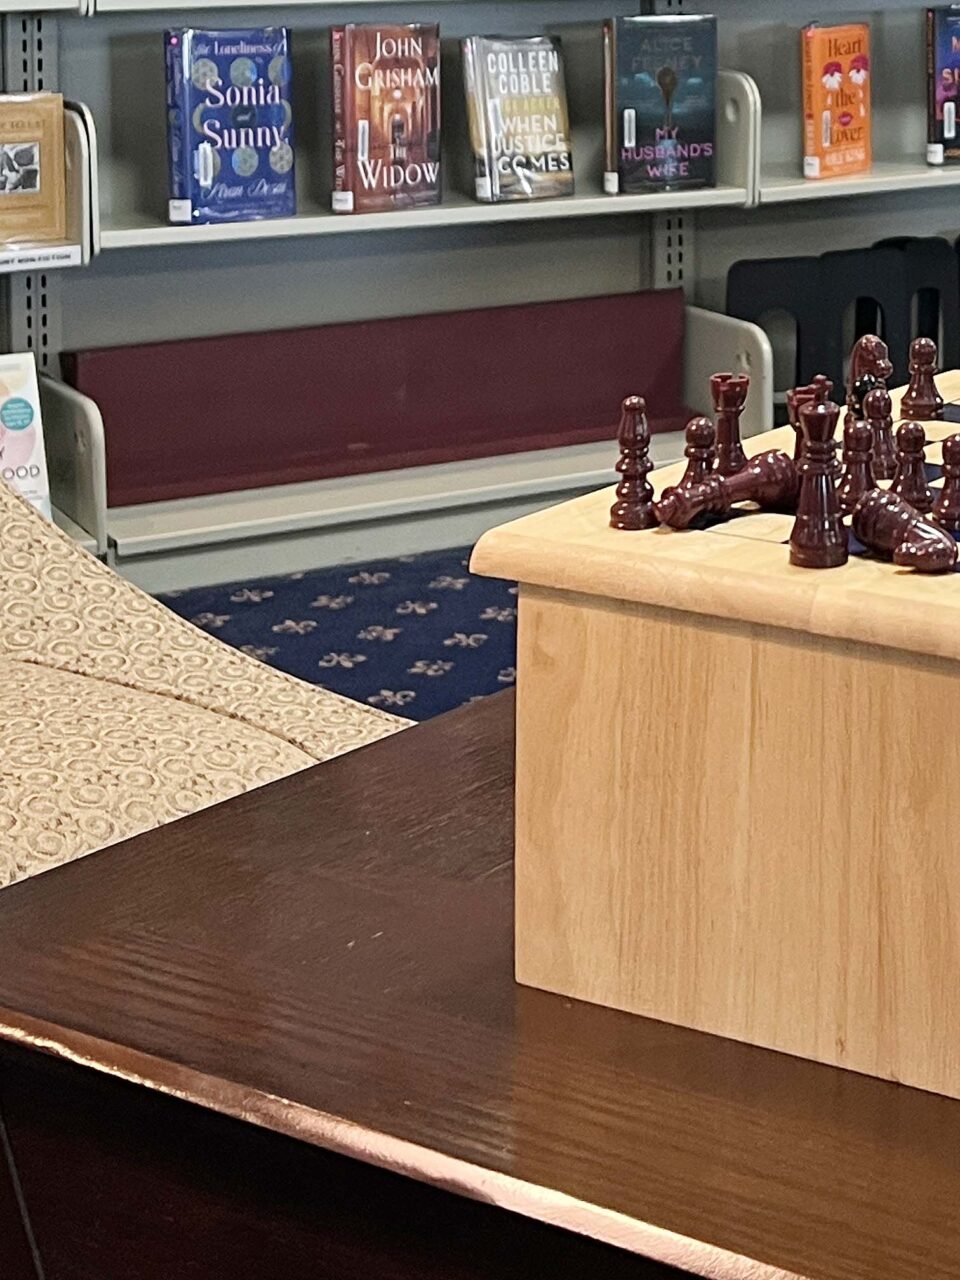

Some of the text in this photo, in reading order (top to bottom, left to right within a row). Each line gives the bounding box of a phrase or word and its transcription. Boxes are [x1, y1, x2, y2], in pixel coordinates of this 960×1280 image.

[375, 31, 423, 59] JOHN
[641, 35, 694, 53] ALICE
[828, 37, 863, 58] Heart
[487, 50, 559, 73] COLLEEN
[355, 61, 440, 91] GRISHAM
[499, 72, 552, 95] COBLE
[205, 77, 281, 108] Sonia
[203, 118, 285, 152] Sunny
[500, 114, 558, 134] WHEN
[655, 126, 680, 141] MY
[493, 132, 567, 156] JUSTICE
[621, 142, 713, 161] HUSBAND'S
[356, 158, 440, 191] WIDOW
[498, 151, 570, 175] COMES
[646, 161, 690, 178] WIFE
